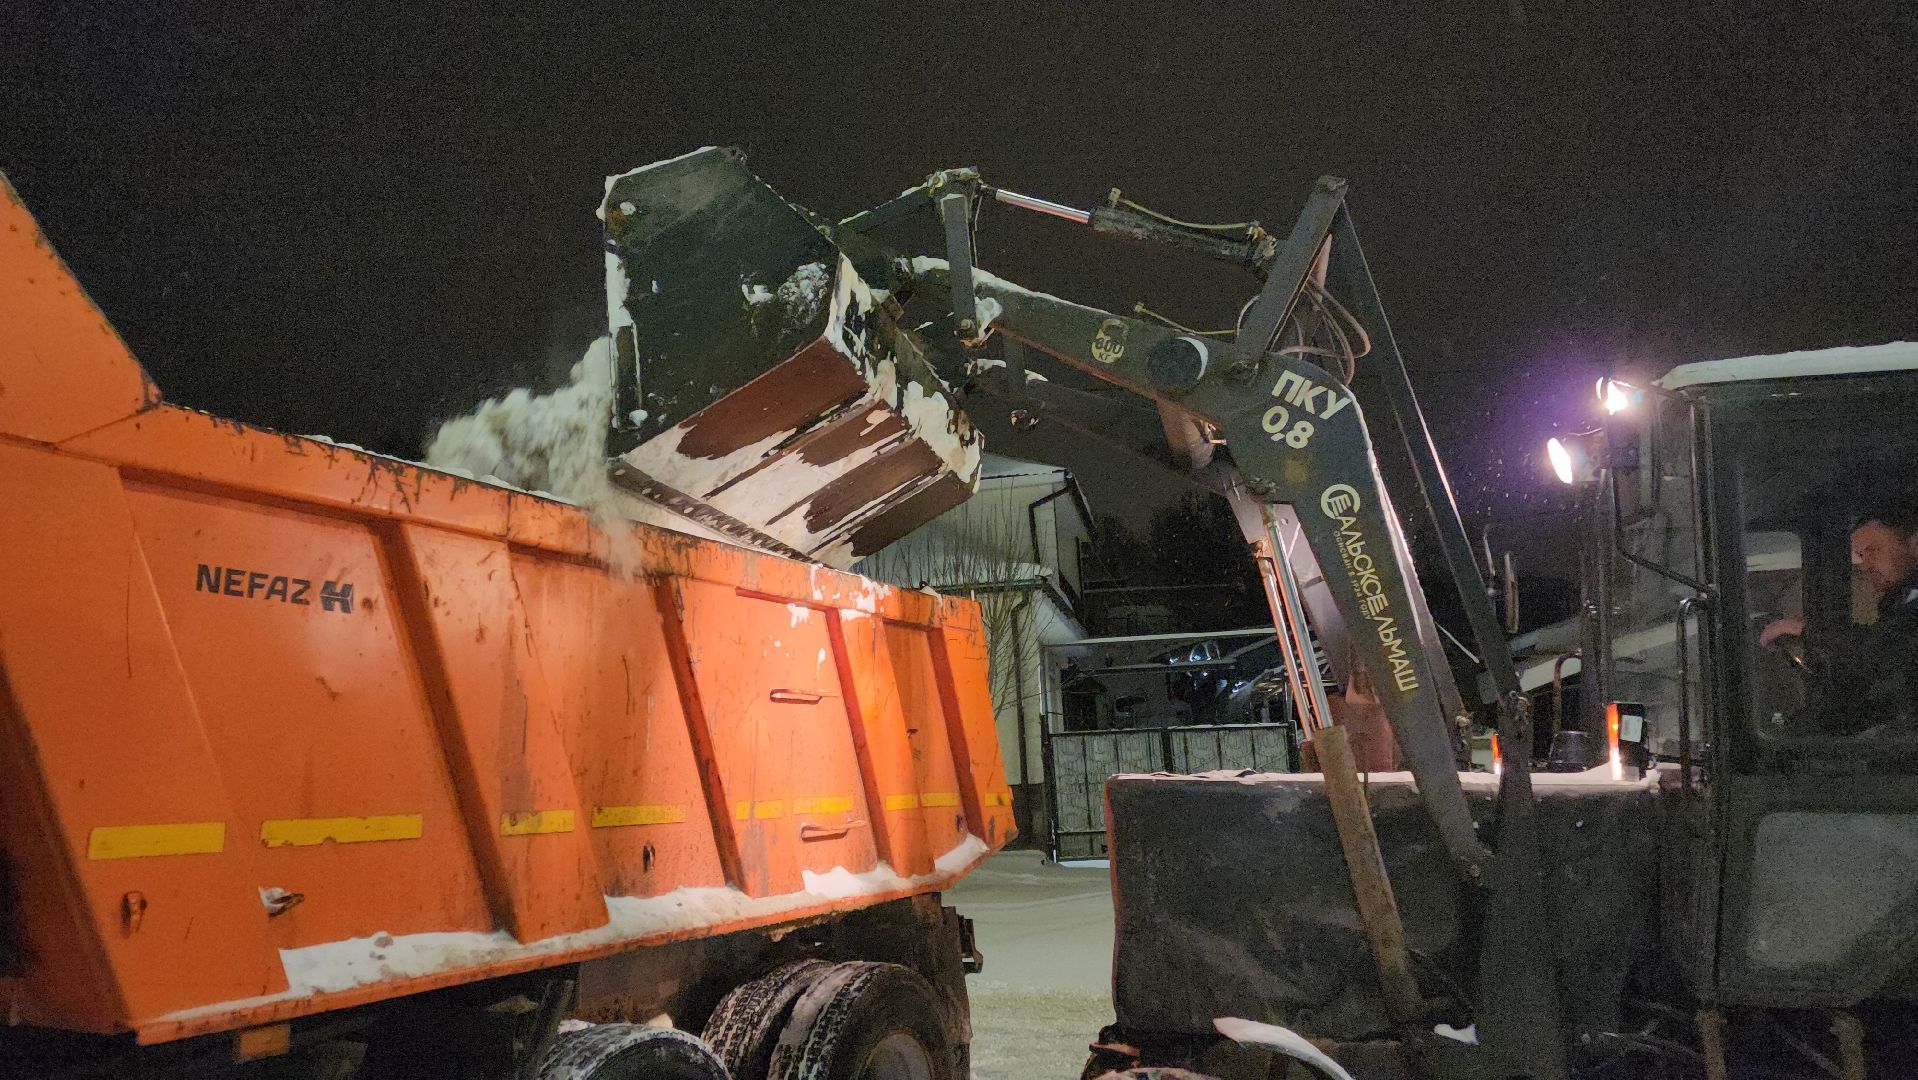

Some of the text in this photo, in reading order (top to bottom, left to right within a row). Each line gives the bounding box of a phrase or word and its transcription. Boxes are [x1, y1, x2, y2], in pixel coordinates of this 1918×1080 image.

[1271, 369, 1353, 420] ПКУ
[1261, 405, 1315, 450] 0,8
[195, 563, 312, 606] NEFAZ
